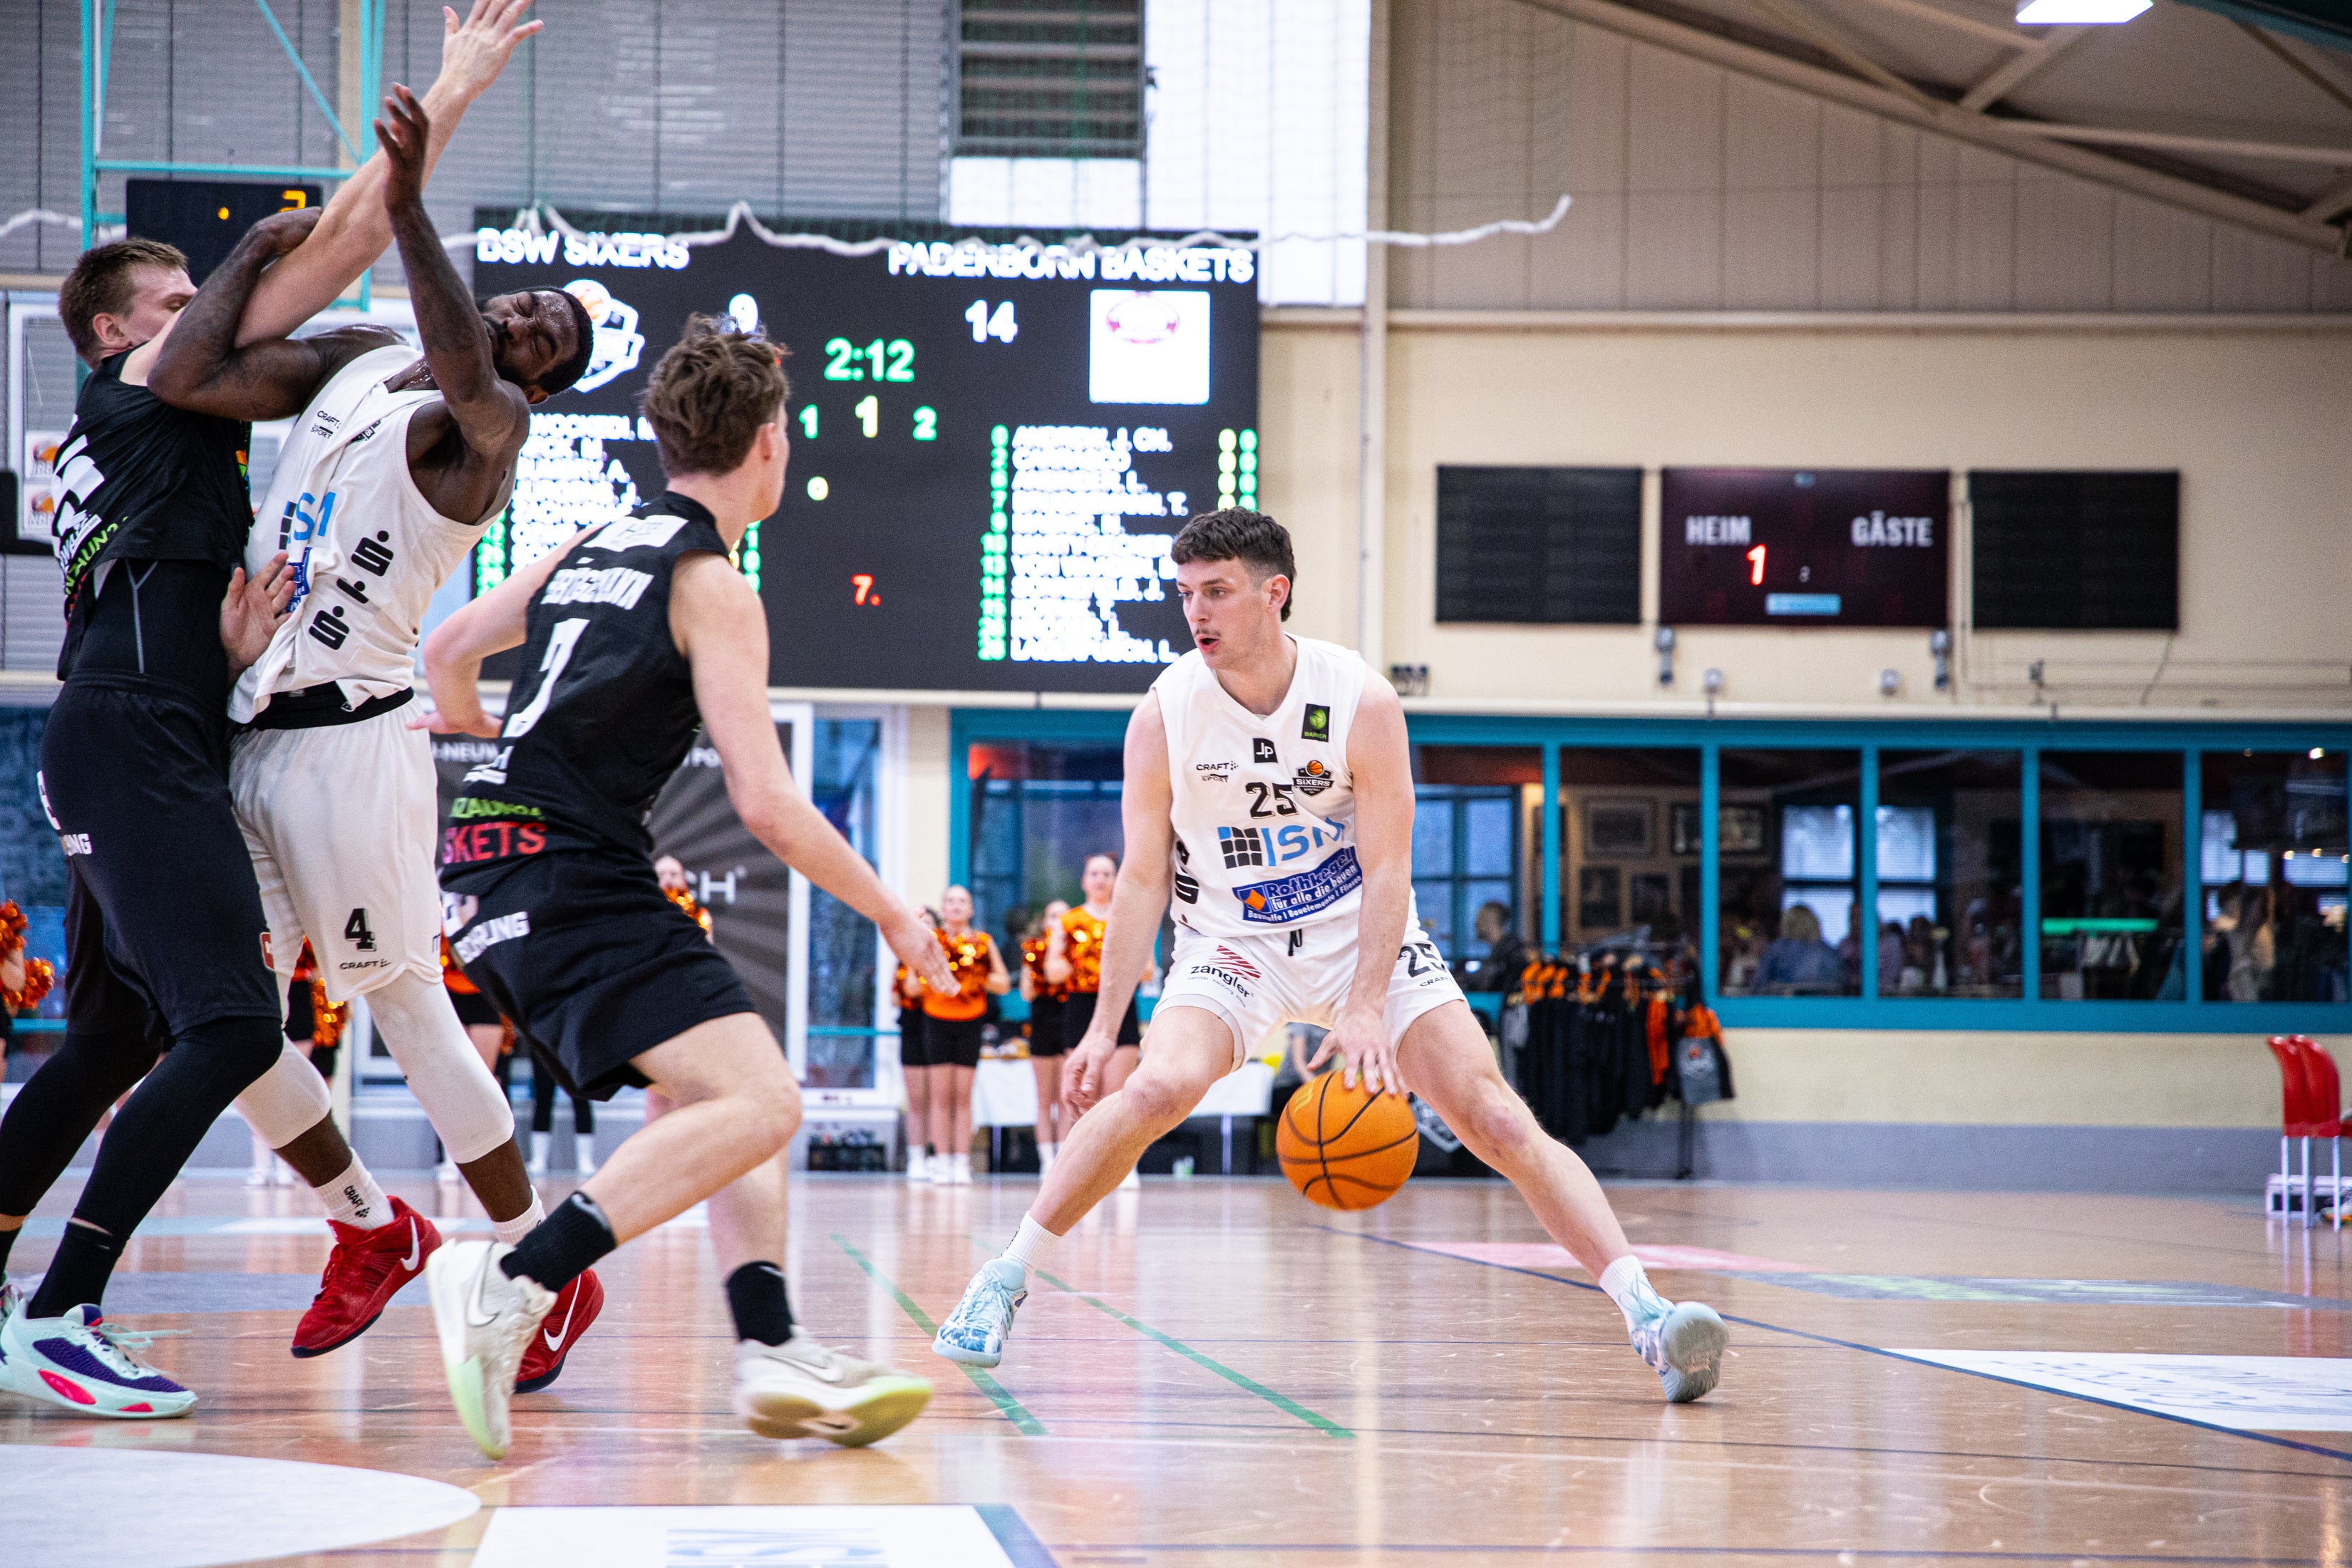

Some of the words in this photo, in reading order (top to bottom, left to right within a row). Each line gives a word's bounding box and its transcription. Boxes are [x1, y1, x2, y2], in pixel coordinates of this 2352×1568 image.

[564, 231, 689, 269] SIXERS
[1100, 247, 1254, 283] BASKETS
[965, 299, 1018, 343] 14
[824, 337, 915, 383] 2:12
[317, 411, 340, 427] CRAFT
[799, 403, 818, 439] 1
[855, 395, 878, 438] 1
[912, 406, 937, 440] 2
[1685, 516, 1751, 545] HEIM
[1852, 510, 1934, 547] GÄSTE
[1745, 544, 1767, 586] 1
[1196, 762, 1229, 770] CRAFT
[1296, 778, 1331, 788] SIXERS
[1245, 782, 1299, 819] 25
[1264, 845, 1354, 897] Rothkegel
[1272, 897, 1288, 910] für
[1291, 888, 1313, 904] alle
[1315, 882, 1331, 899] die
[1330, 865, 1357, 888] bauen
[344, 907, 377, 951] 4
[339, 960, 378, 970] CRAFT
[1190, 965, 1250, 998] zangler
[344, 1185, 364, 1207] CRAFT
